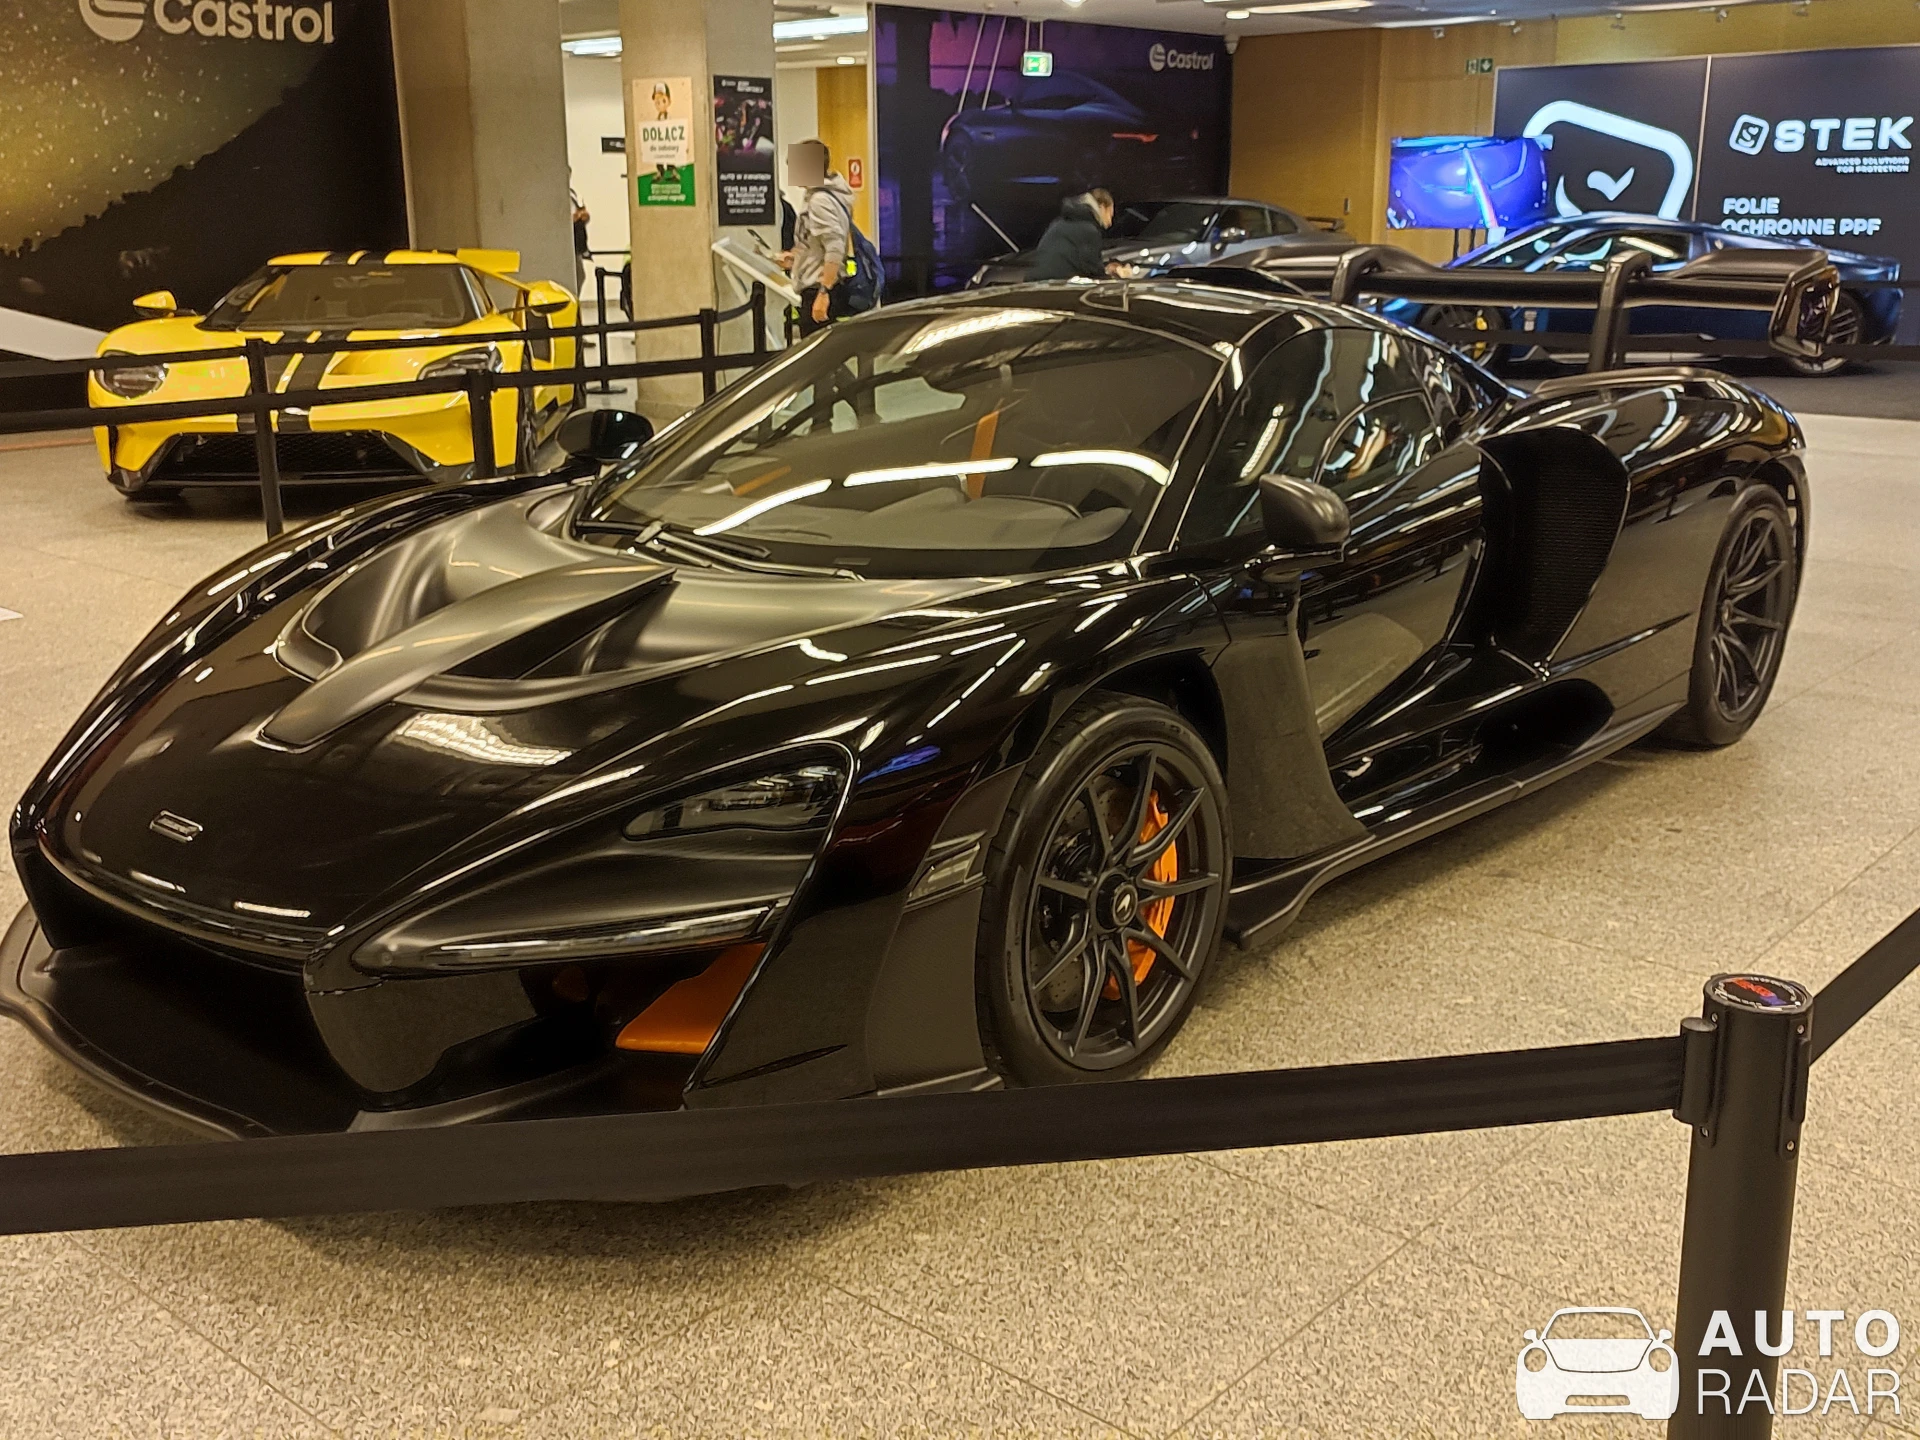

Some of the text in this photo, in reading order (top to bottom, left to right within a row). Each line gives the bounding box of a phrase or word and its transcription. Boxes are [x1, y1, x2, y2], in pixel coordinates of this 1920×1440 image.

[153, 0, 334, 44] Castrol
[1166, 49, 1215, 70] Castrol
[642, 126, 685, 142] DOŁĄCZ
[1773, 116, 1914, 153] STEK
[1815, 156, 1910, 166] ADVANCED SOLUTIONS
[1836, 165, 1909, 173] FOR PROTECTION
[1722, 197, 1780, 215] FOLIE
[1721, 218, 1881, 236] OCHRONNE PPF
